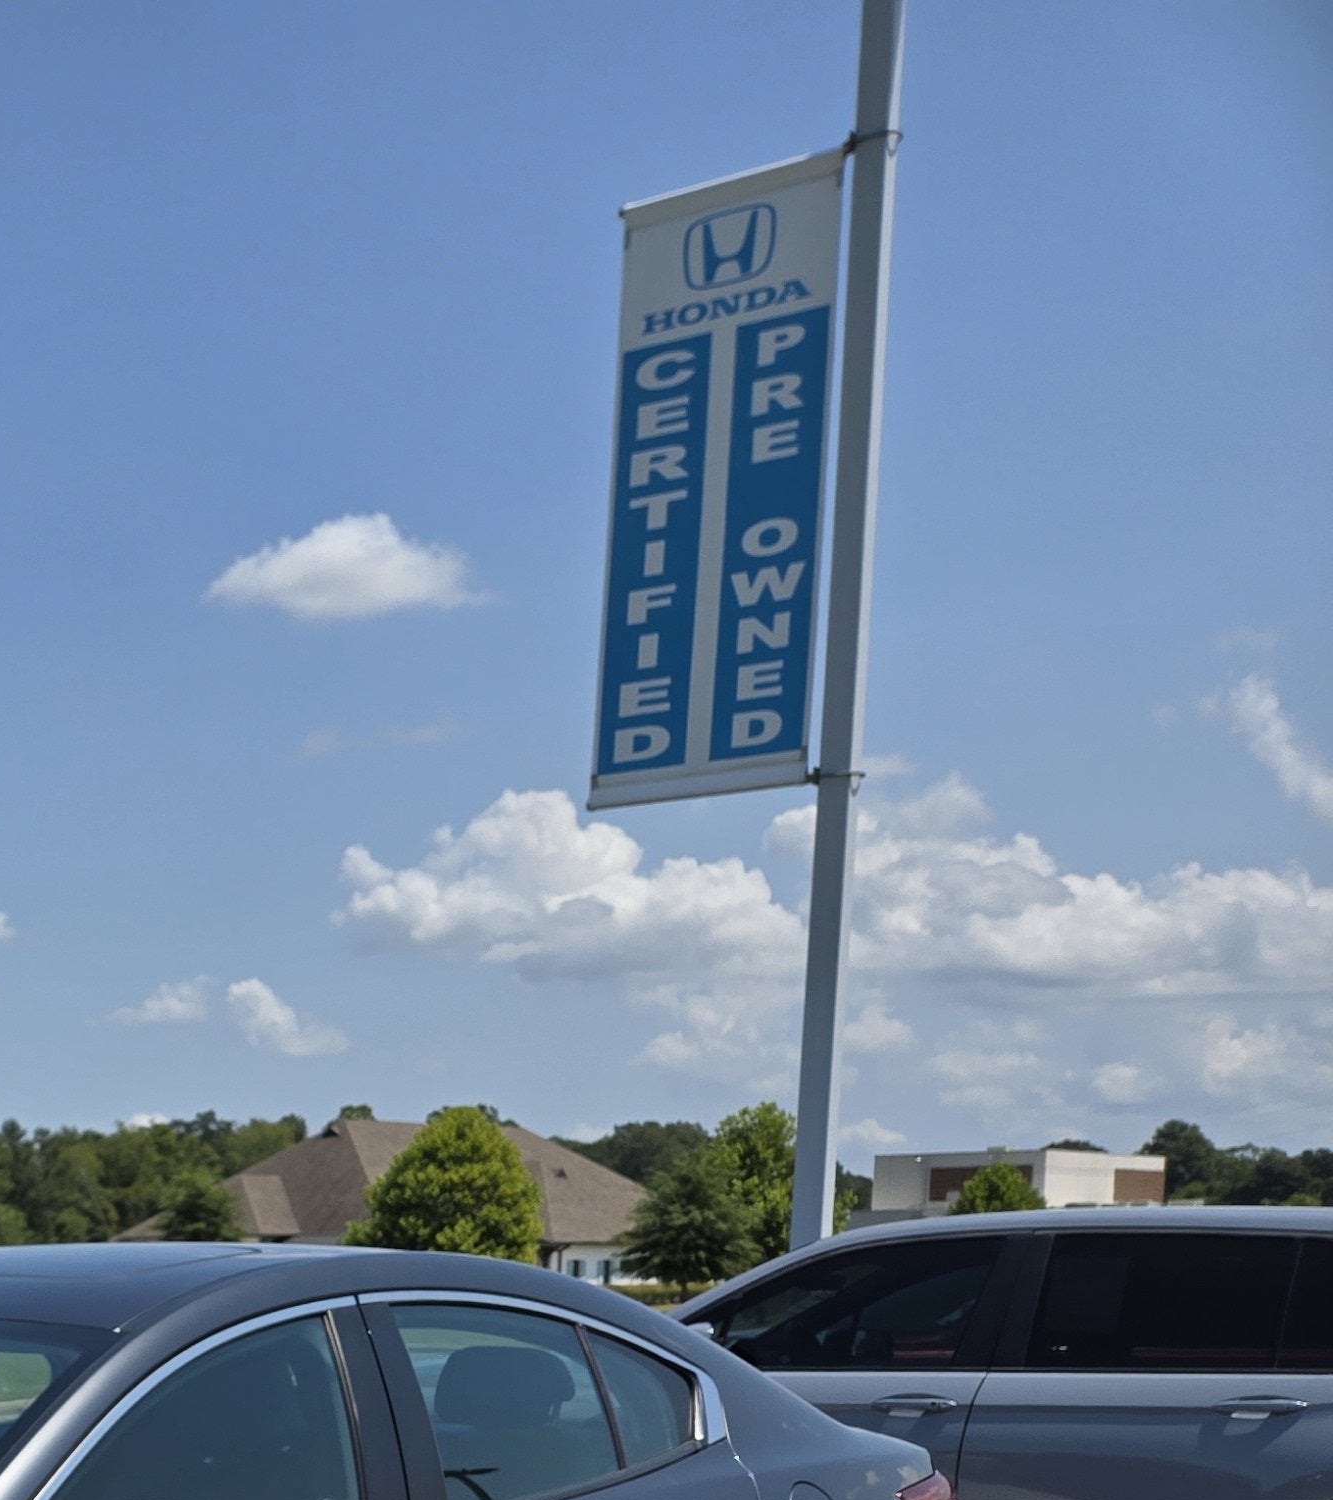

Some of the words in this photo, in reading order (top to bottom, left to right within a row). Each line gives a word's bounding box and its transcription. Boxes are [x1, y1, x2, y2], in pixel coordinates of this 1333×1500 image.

[641, 277, 812, 336] HONDA
[749, 323, 807, 465] PRE
[612, 349, 696, 765] CERTIFIED
[730, 516, 808, 750] OWNED
